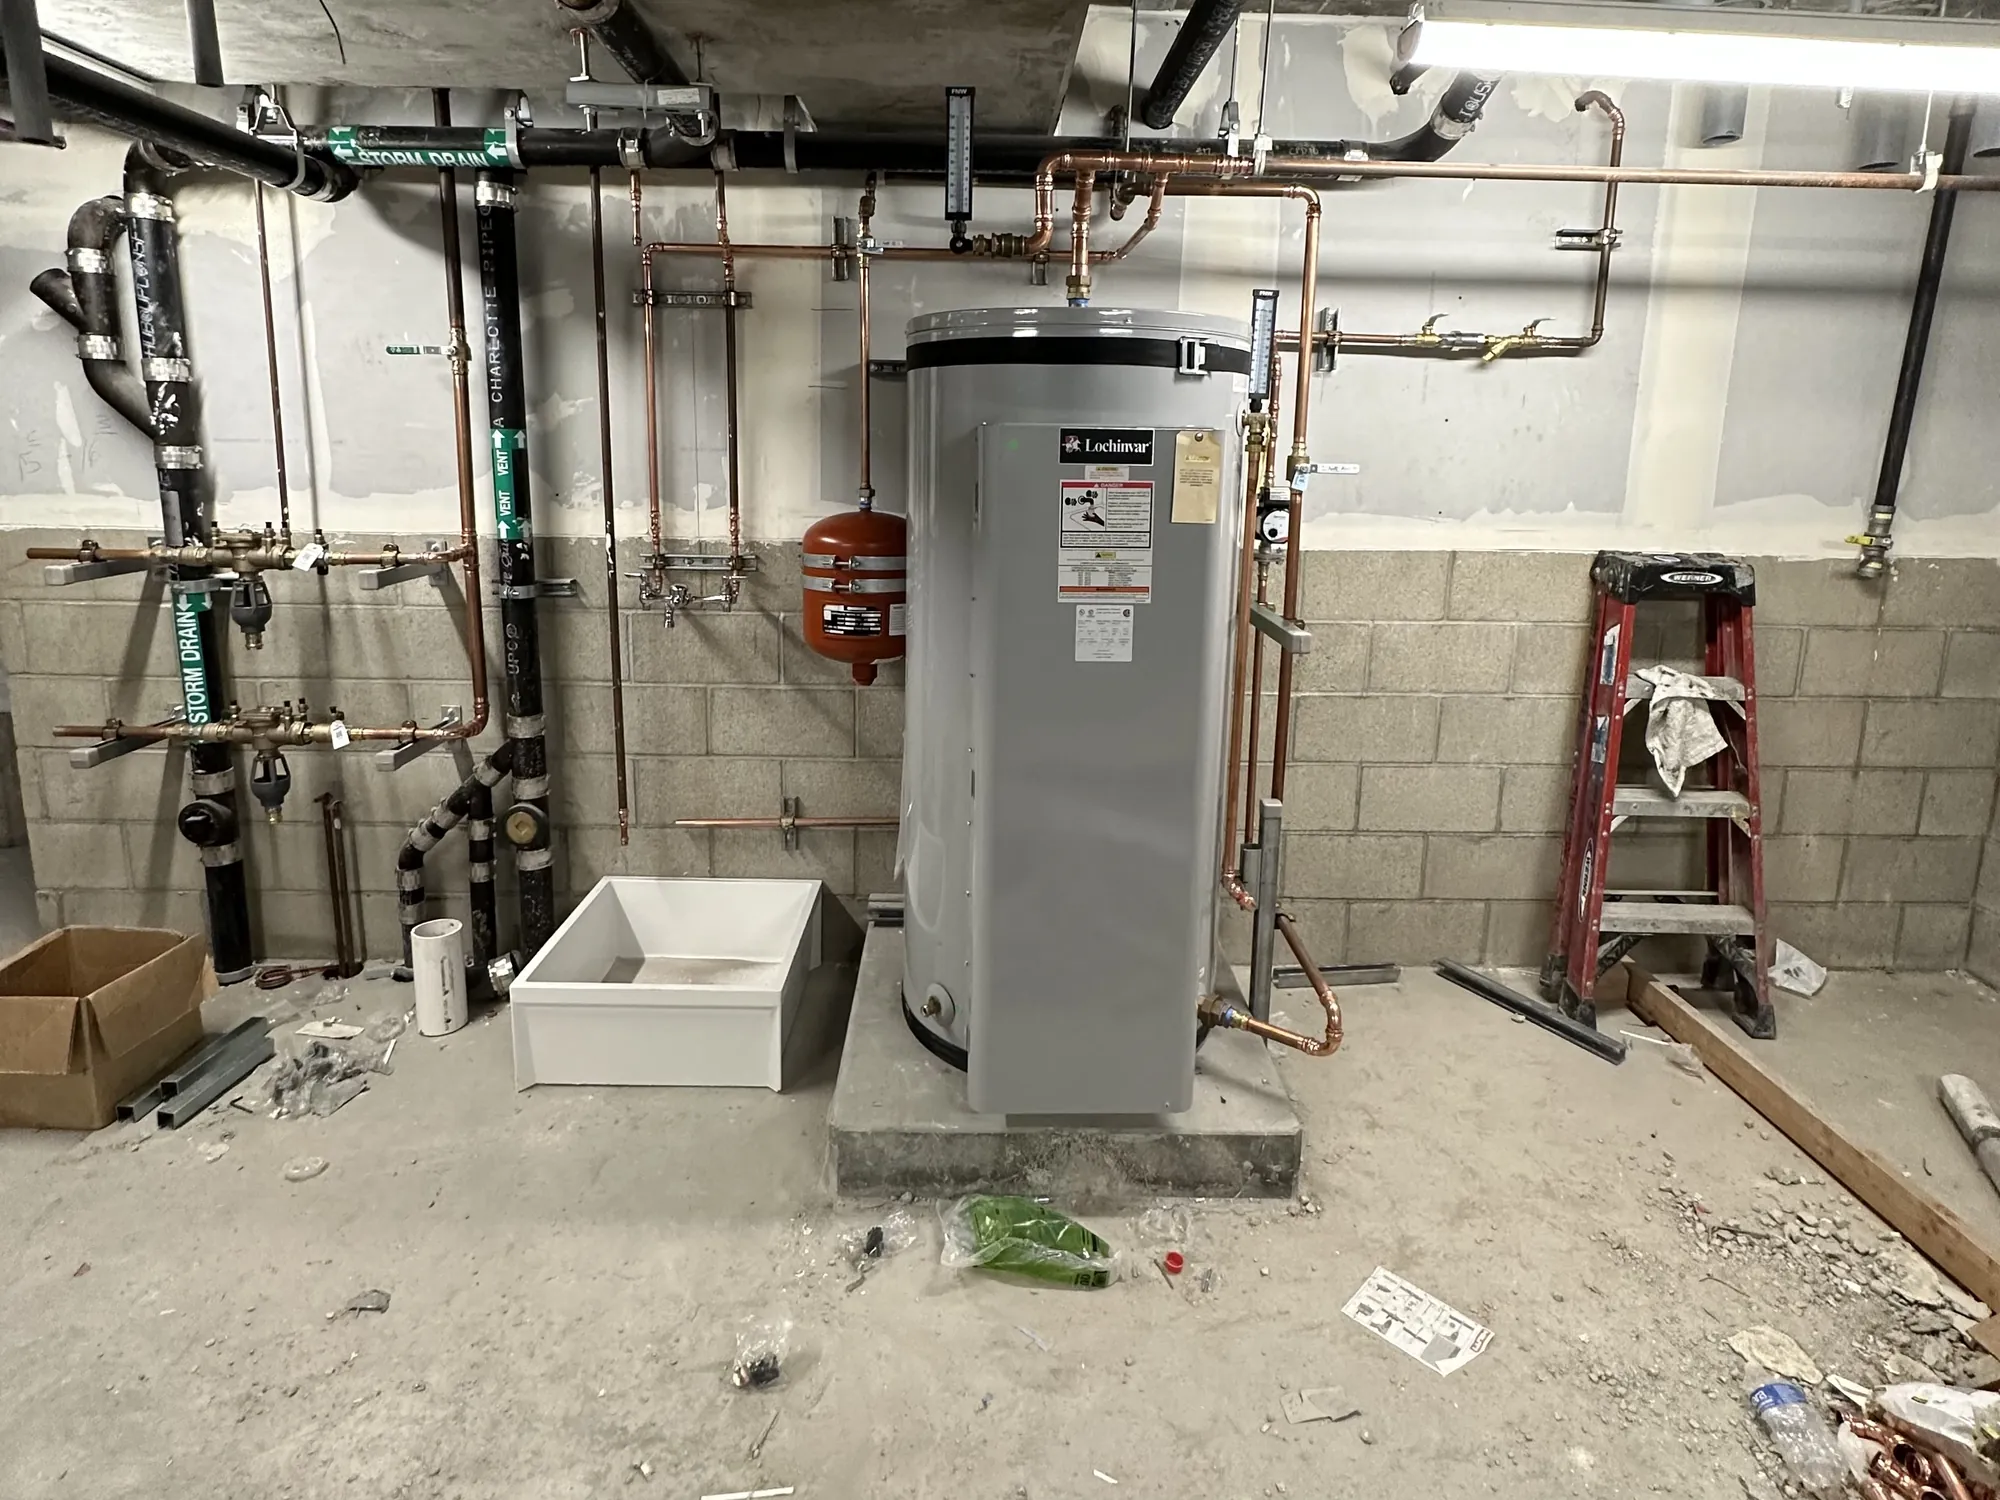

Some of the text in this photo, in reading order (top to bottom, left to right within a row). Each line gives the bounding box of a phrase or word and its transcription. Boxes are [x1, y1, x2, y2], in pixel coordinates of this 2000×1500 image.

[358, 151, 490, 167] STORM DRAIN
[485, 286, 503, 403] CHARLOTTE
[493, 417, 505, 429] A
[1085, 438, 1150, 453] Lochinvar
[496, 450, 512, 517] VENT VENT
[1673, 573, 1712, 582] WERNER
[175, 611, 209, 724] STORM DRAIN
